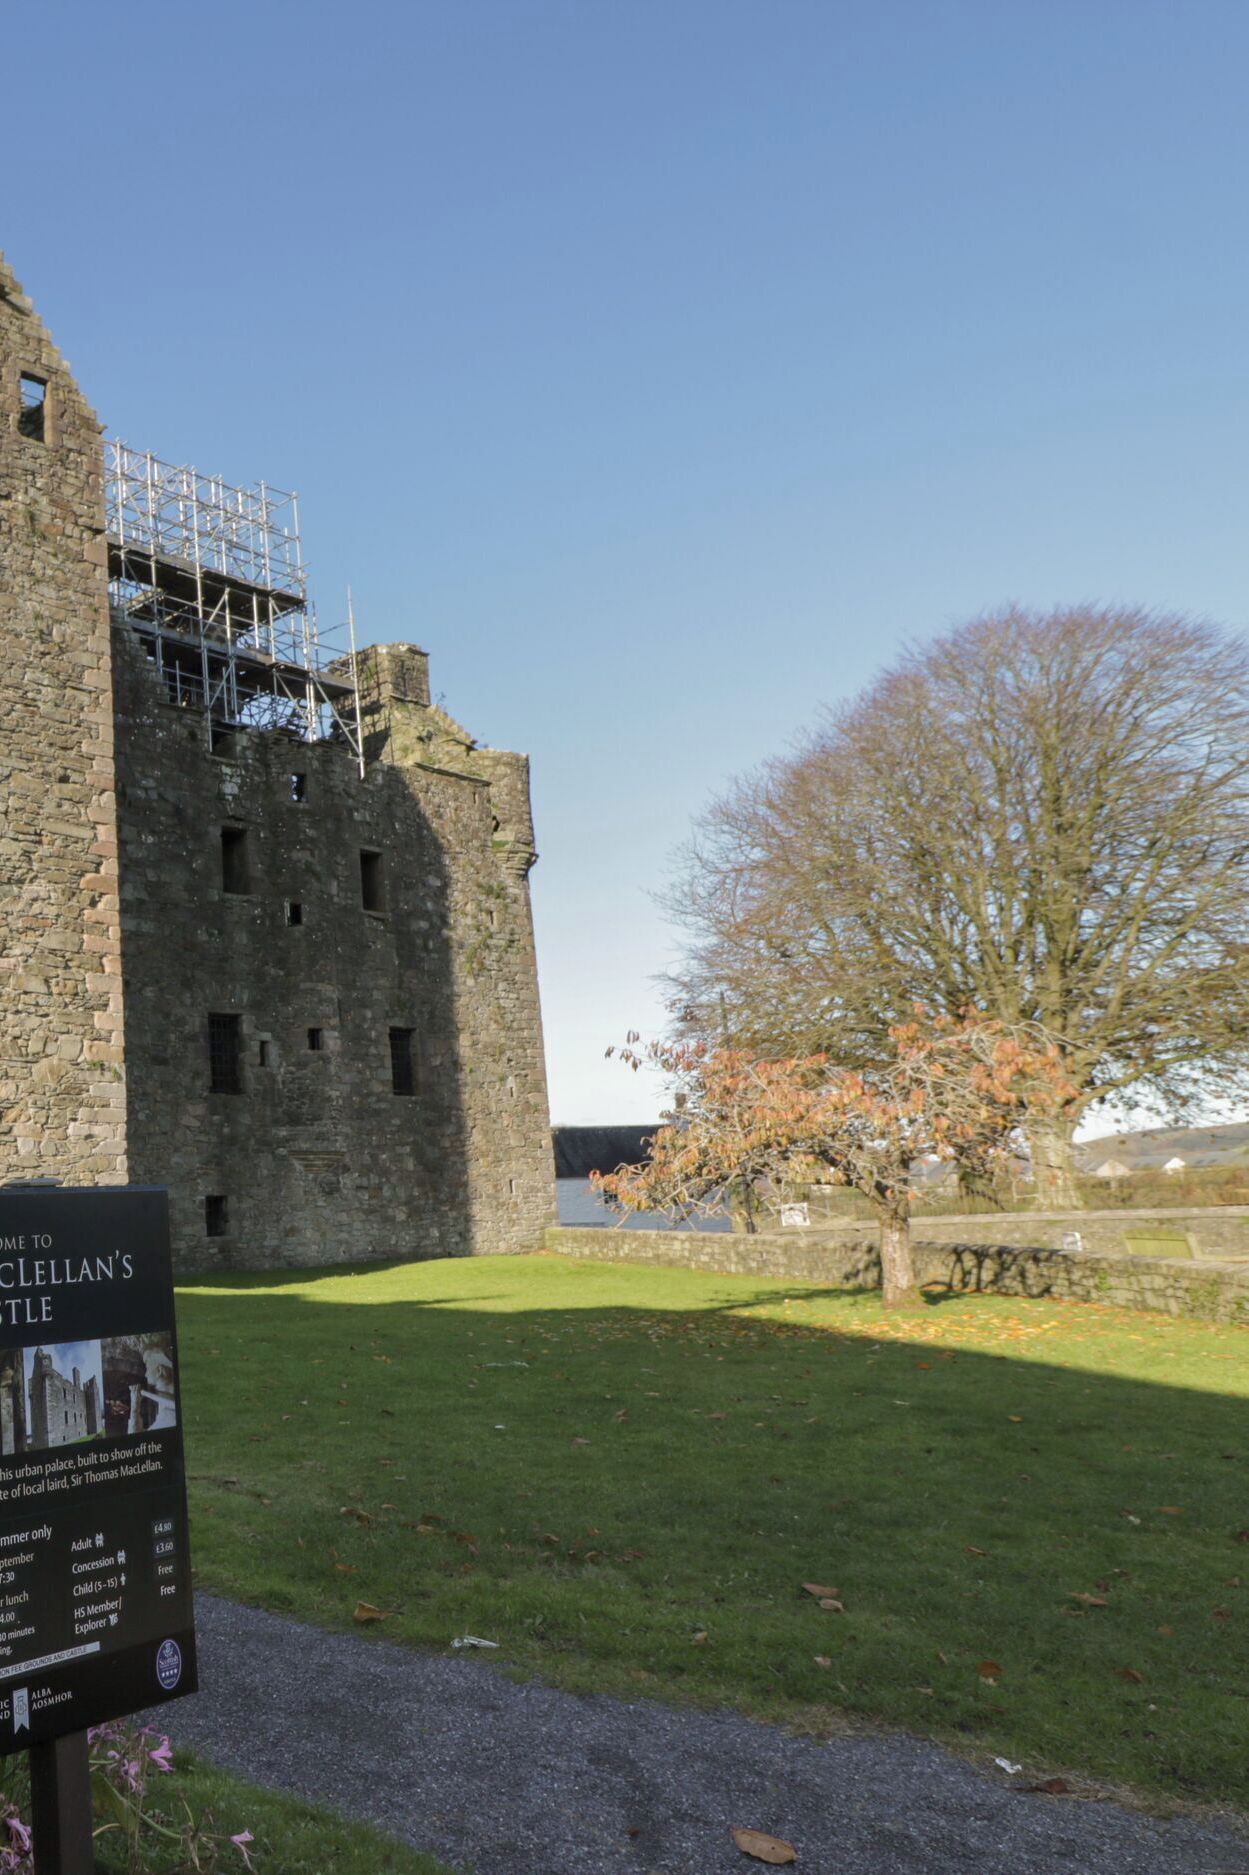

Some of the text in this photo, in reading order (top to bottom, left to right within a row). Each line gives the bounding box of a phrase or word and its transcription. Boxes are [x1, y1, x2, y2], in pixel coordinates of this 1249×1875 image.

[31, 1234, 52, 1249] TO
[15, 1463, 43, 1478] urban
[45, 1458, 76, 1474] palace,
[77, 1452, 98, 1467] built
[99, 1452, 109, 1463] to
[110, 1447, 133, 1461] show
[134, 1442, 148, 1457] off
[148, 1441, 162, 1454] the
[11, 1483, 23, 1498] of
[23, 1479, 45, 1495] local
[47, 1475, 70, 1492] laird,
[71, 1474, 82, 1487] Sir
[84, 1467, 119, 1484] Thomas
[120, 1459, 163, 1477] MacLellan.
[31, 1523, 52, 1540] only
[71, 1537, 92, 1552] Adult
[72, 1557, 114, 1574] Concession
[158, 1565, 173, 1575] Free
[73, 1581, 93, 1597] Child
[160, 1585, 176, 1596] Free
[5, 1590, 29, 1606] lunch
[74, 1607, 86, 1619] HS
[7, 1626, 35, 1640] minutes
[75, 1618, 106, 1635] Explorer
[11, 1665, 23, 1674] FEE
[23, 1658, 52, 1670] GROUNDS
[53, 1652, 66, 1662] AND
[67, 1646, 87, 1658] CASTLE
[31, 1687, 51, 1700] ALBA
[32, 1690, 73, 1711] AOSMHOR
